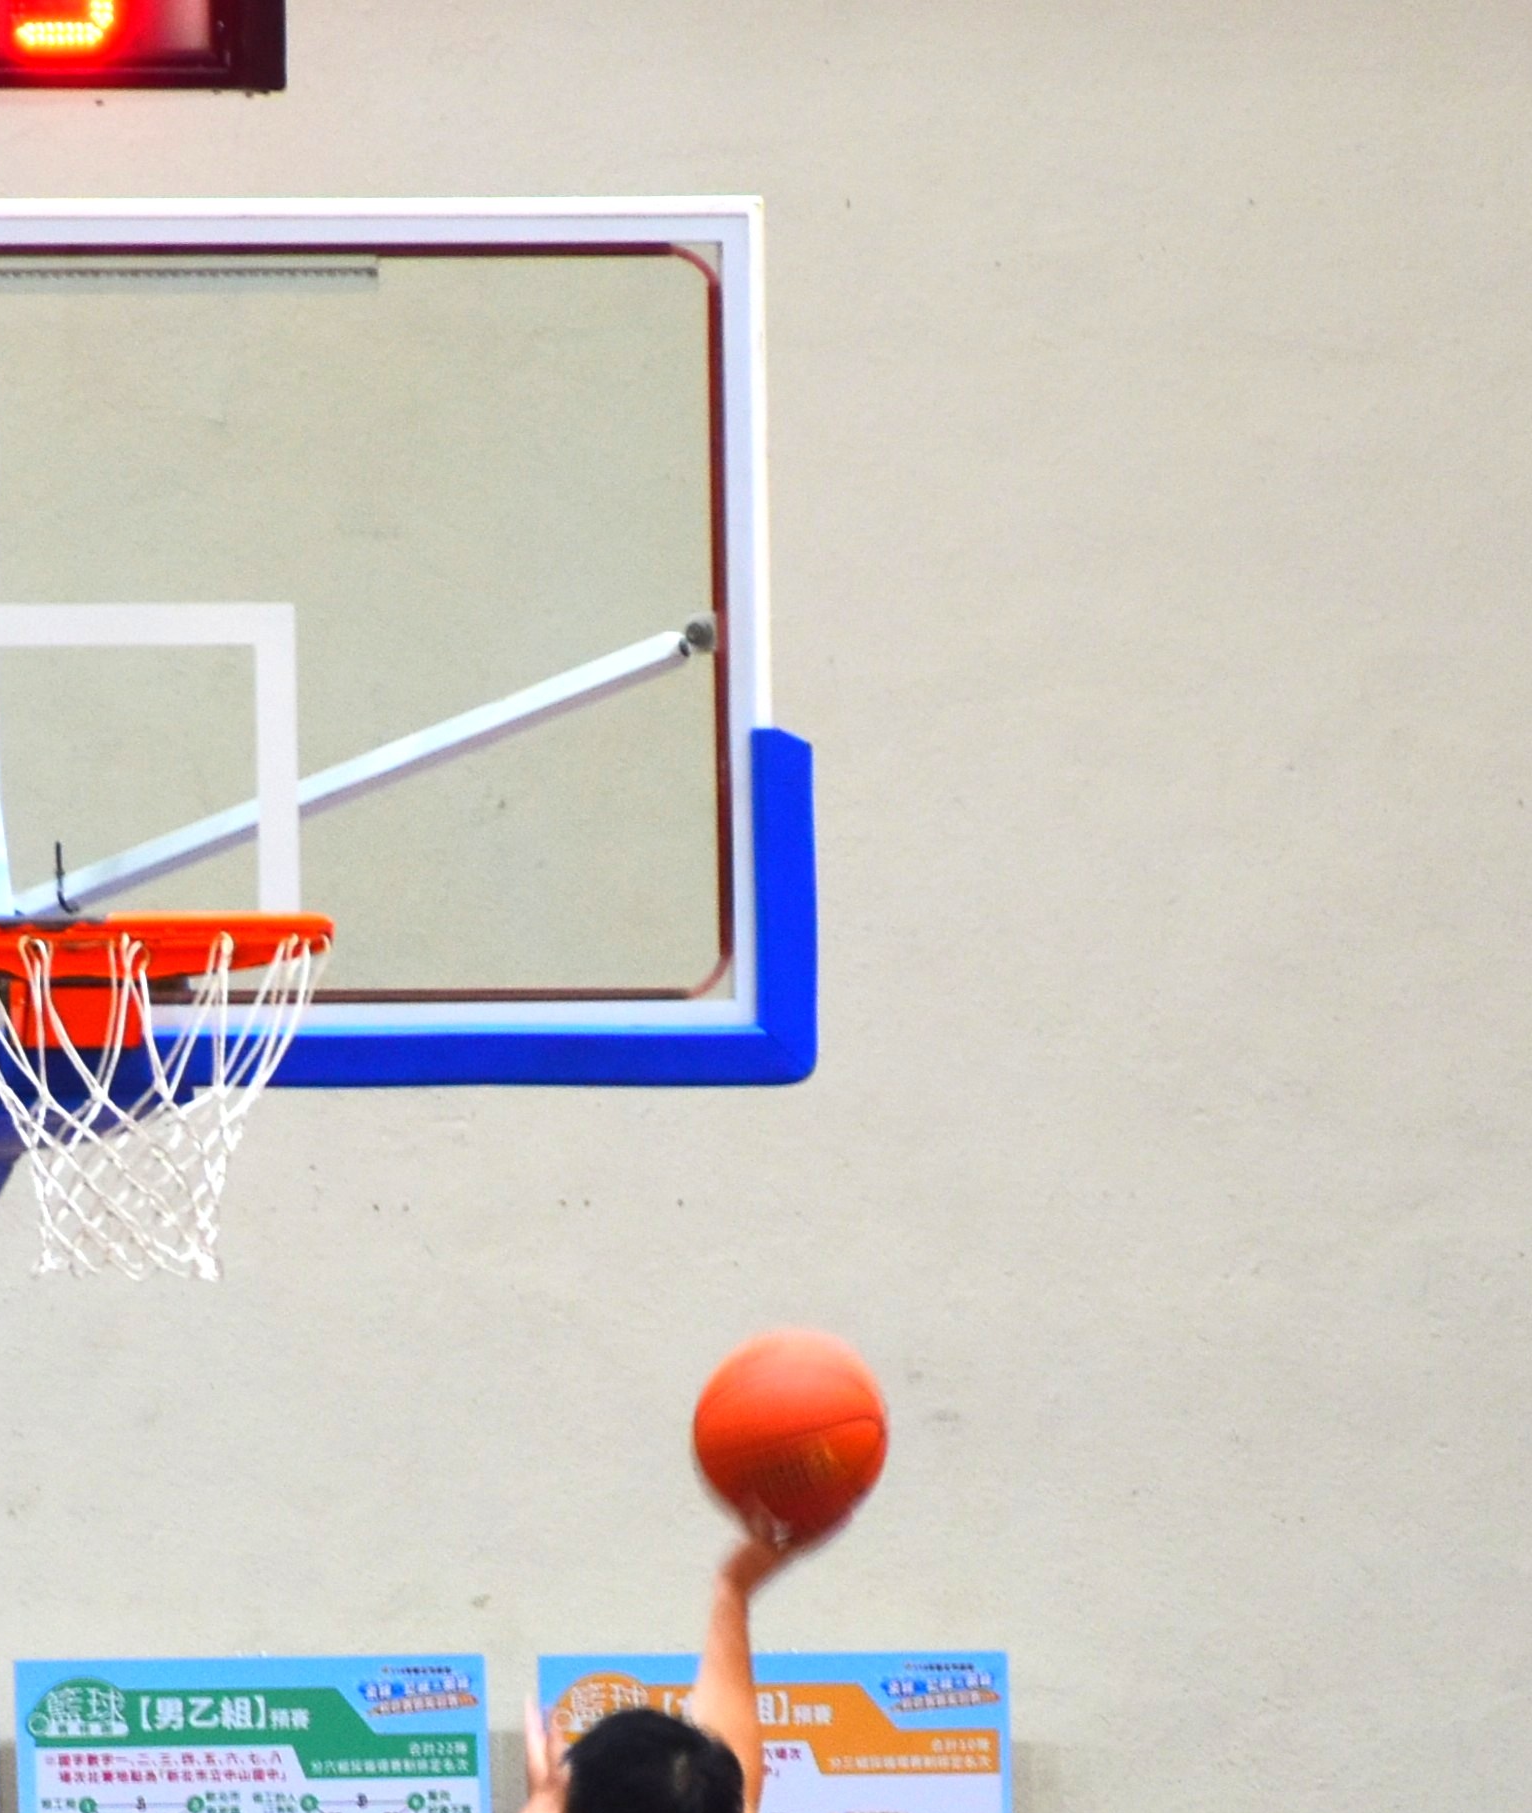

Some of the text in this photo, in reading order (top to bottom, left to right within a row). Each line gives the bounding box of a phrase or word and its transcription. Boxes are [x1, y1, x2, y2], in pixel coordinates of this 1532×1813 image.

[47, 1688, 125, 1724] 籃球
[140, 1695, 266, 1731] 【男乙組】
